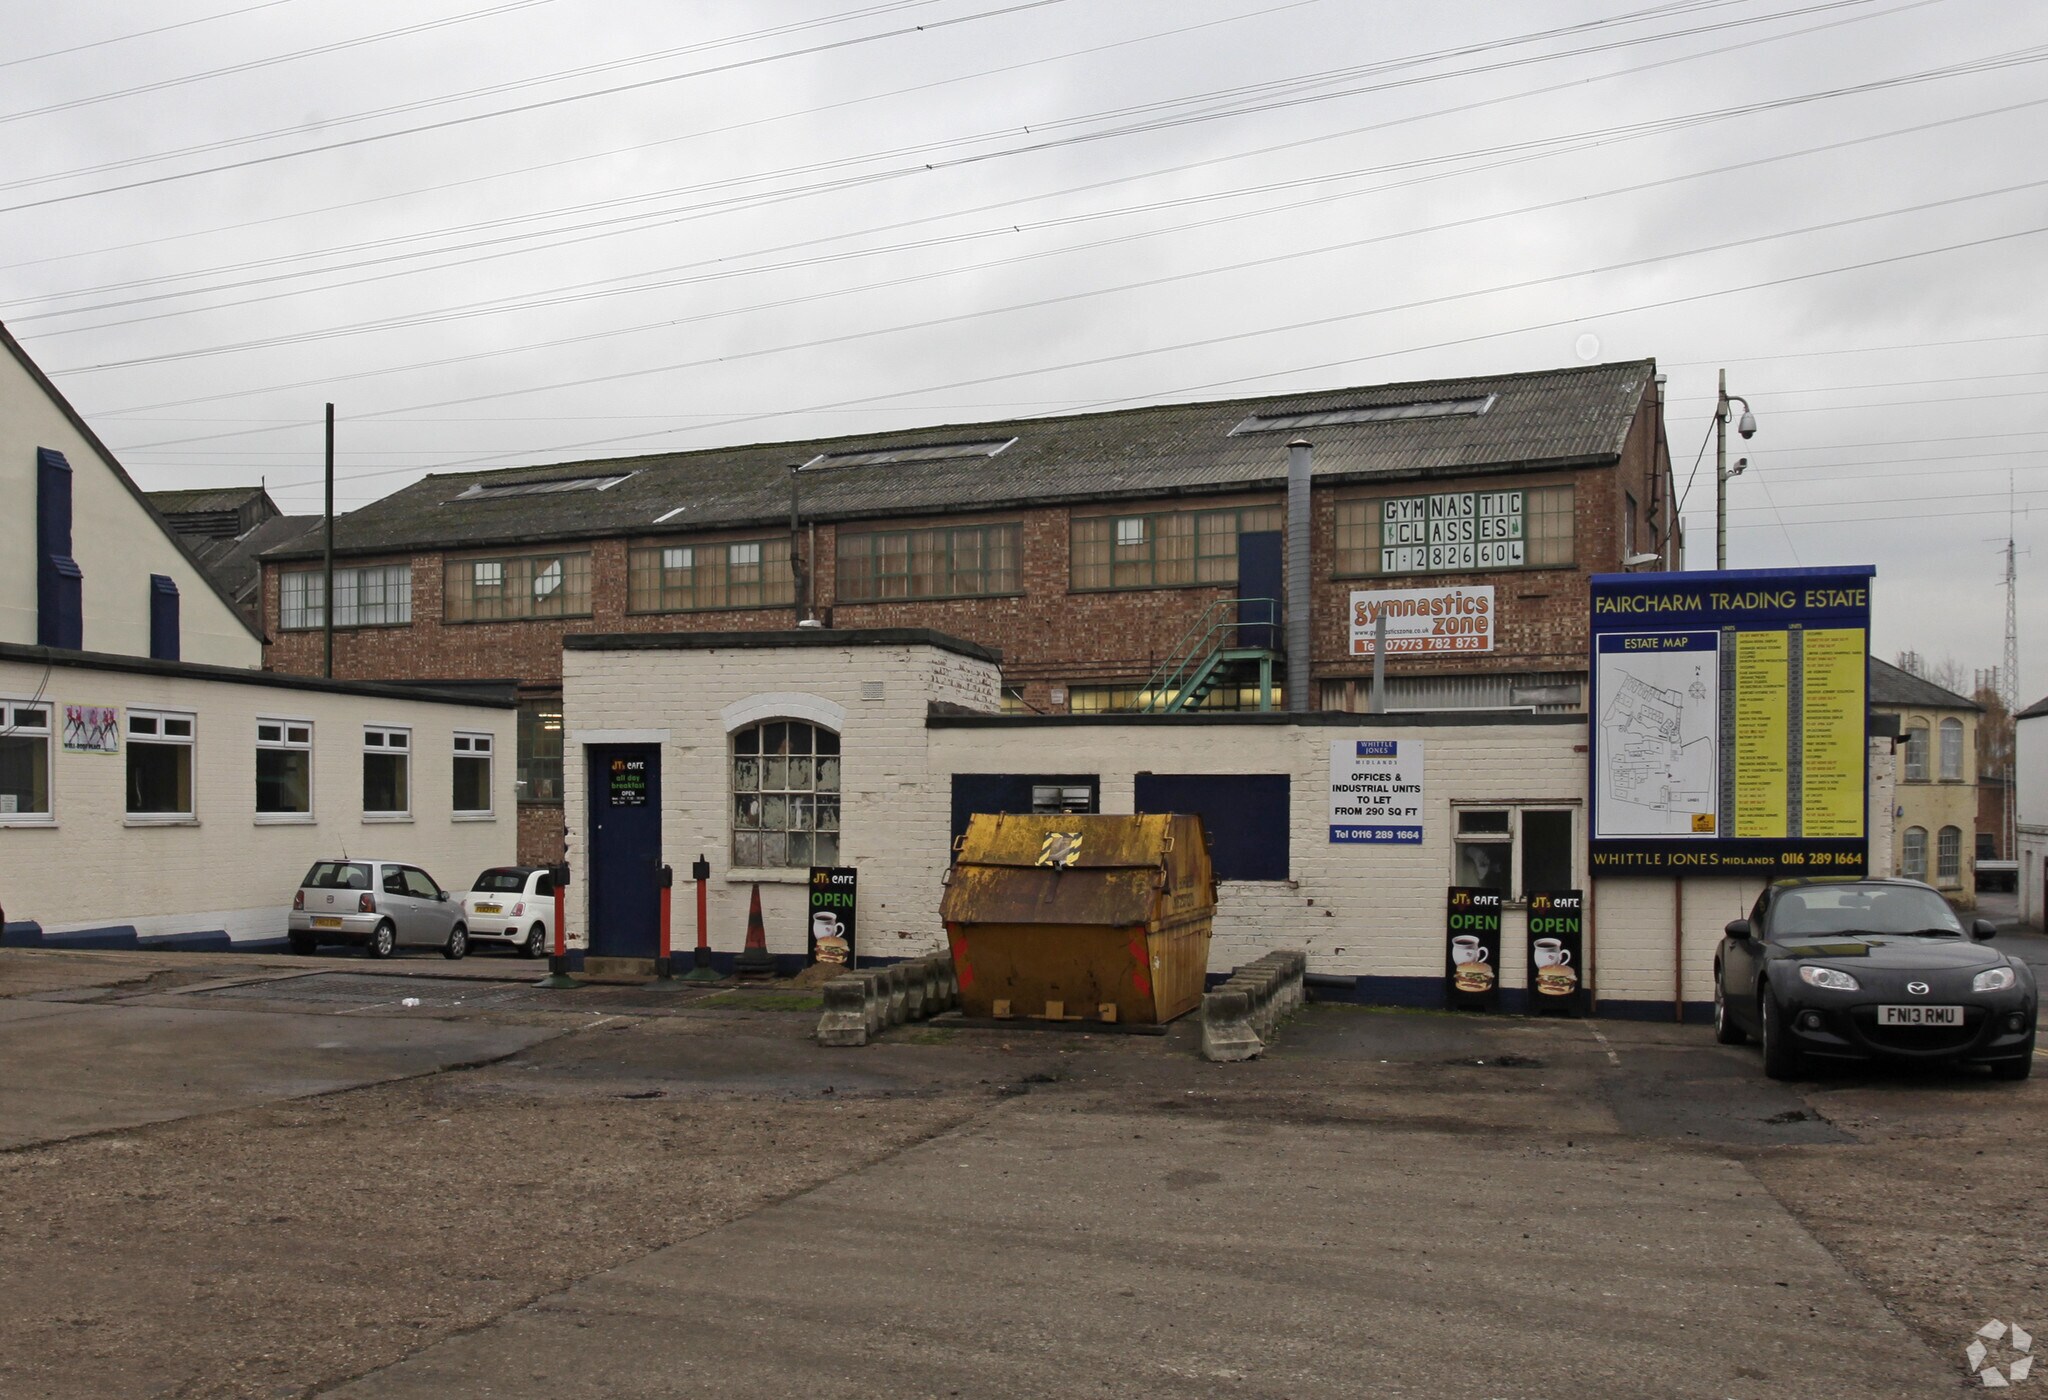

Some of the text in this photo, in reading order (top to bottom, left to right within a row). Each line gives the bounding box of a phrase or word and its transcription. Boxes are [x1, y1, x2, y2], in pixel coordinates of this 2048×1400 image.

[1386, 495, 1520, 519] GYMNASTIC
[1400, 518, 1506, 542] CLASSES
[1354, 591, 1488, 626] gymnastics
[1596, 589, 1866, 614] FAIRCHARM TRADING ESTATE
[1354, 627, 1429, 637] www.gyasticszone.co.uk
[1432, 615, 1488, 635] zone
[1385, 639, 1423, 650] 07973
[1428, 638, 1451, 649] 782
[1455, 637, 1480, 648] 873
[1624, 637, 1688, 649] ESTATE MAP
[1351, 773, 1402, 781] OFFICES &
[1335, 807, 1362, 815] FROM
[1366, 807, 1384, 815] 290
[1388, 808, 1402, 816] SQ
[1335, 830, 1419, 839] Tel 0116 289 1664
[1594, 853, 1862, 865] WHITTLE JONES MIDLANDS 0116 289 1664
[811, 892, 853, 907] OPEN
[1450, 914, 1498, 930] OPEN
[1530, 918, 1579, 933] OPEN
[1887, 1008, 1954, 1023] FN13 RMU
